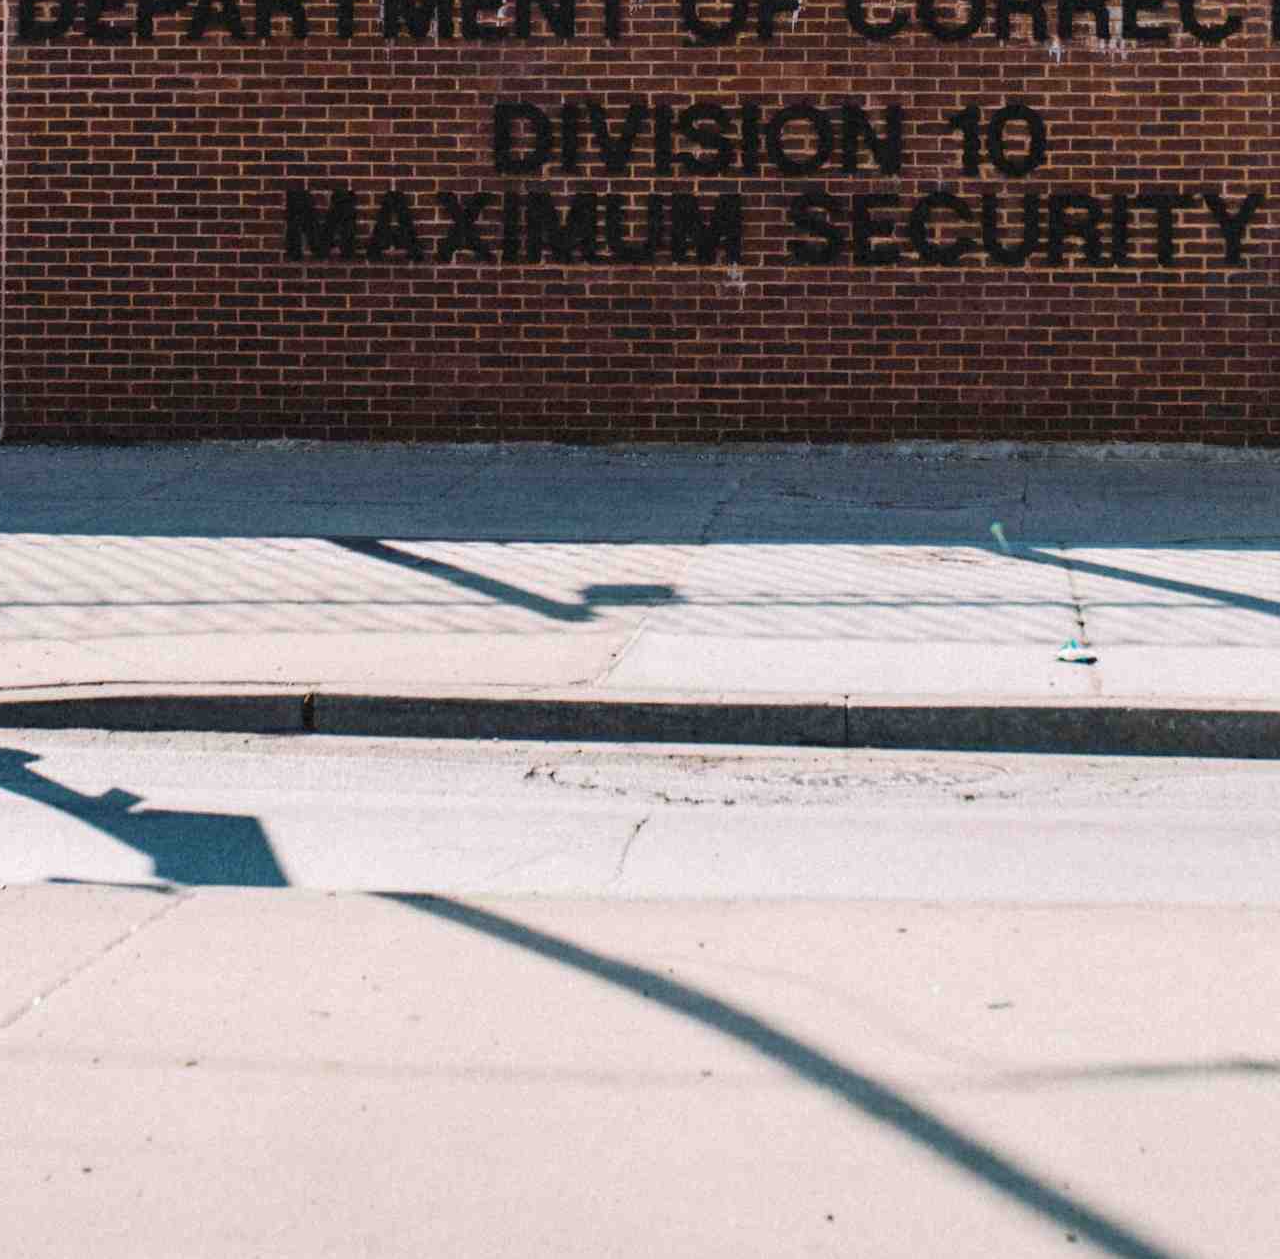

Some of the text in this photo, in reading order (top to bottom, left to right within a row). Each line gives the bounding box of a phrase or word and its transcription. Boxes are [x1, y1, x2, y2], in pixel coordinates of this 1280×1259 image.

[494, 101, 1047, 177] DIVISION 10
[287, 189, 1266, 267] MAXIMUM SECURITY
